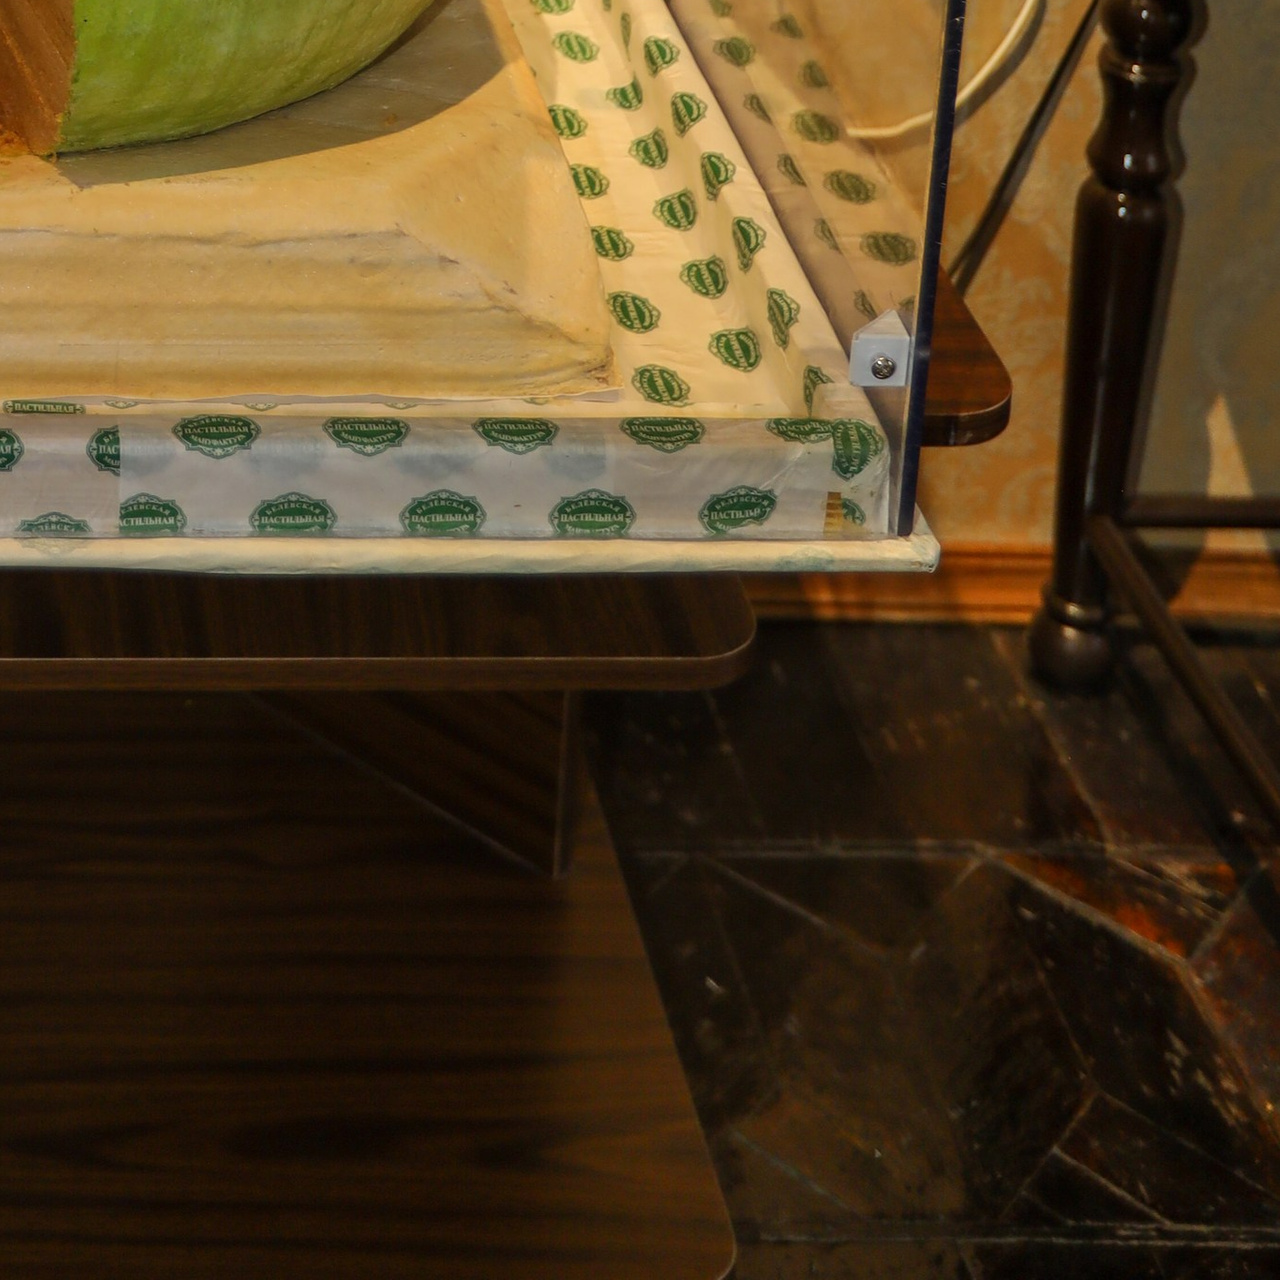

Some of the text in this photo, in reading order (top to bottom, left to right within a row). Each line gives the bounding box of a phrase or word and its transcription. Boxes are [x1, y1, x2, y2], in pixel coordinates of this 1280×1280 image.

[260, 515, 325, 524] ПАСТИЛЬНАЯ
[411, 513, 475, 523] ПАСТИЛЬНАЯ
[560, 513, 625, 522] ПАСТИЛЬНАЯ
